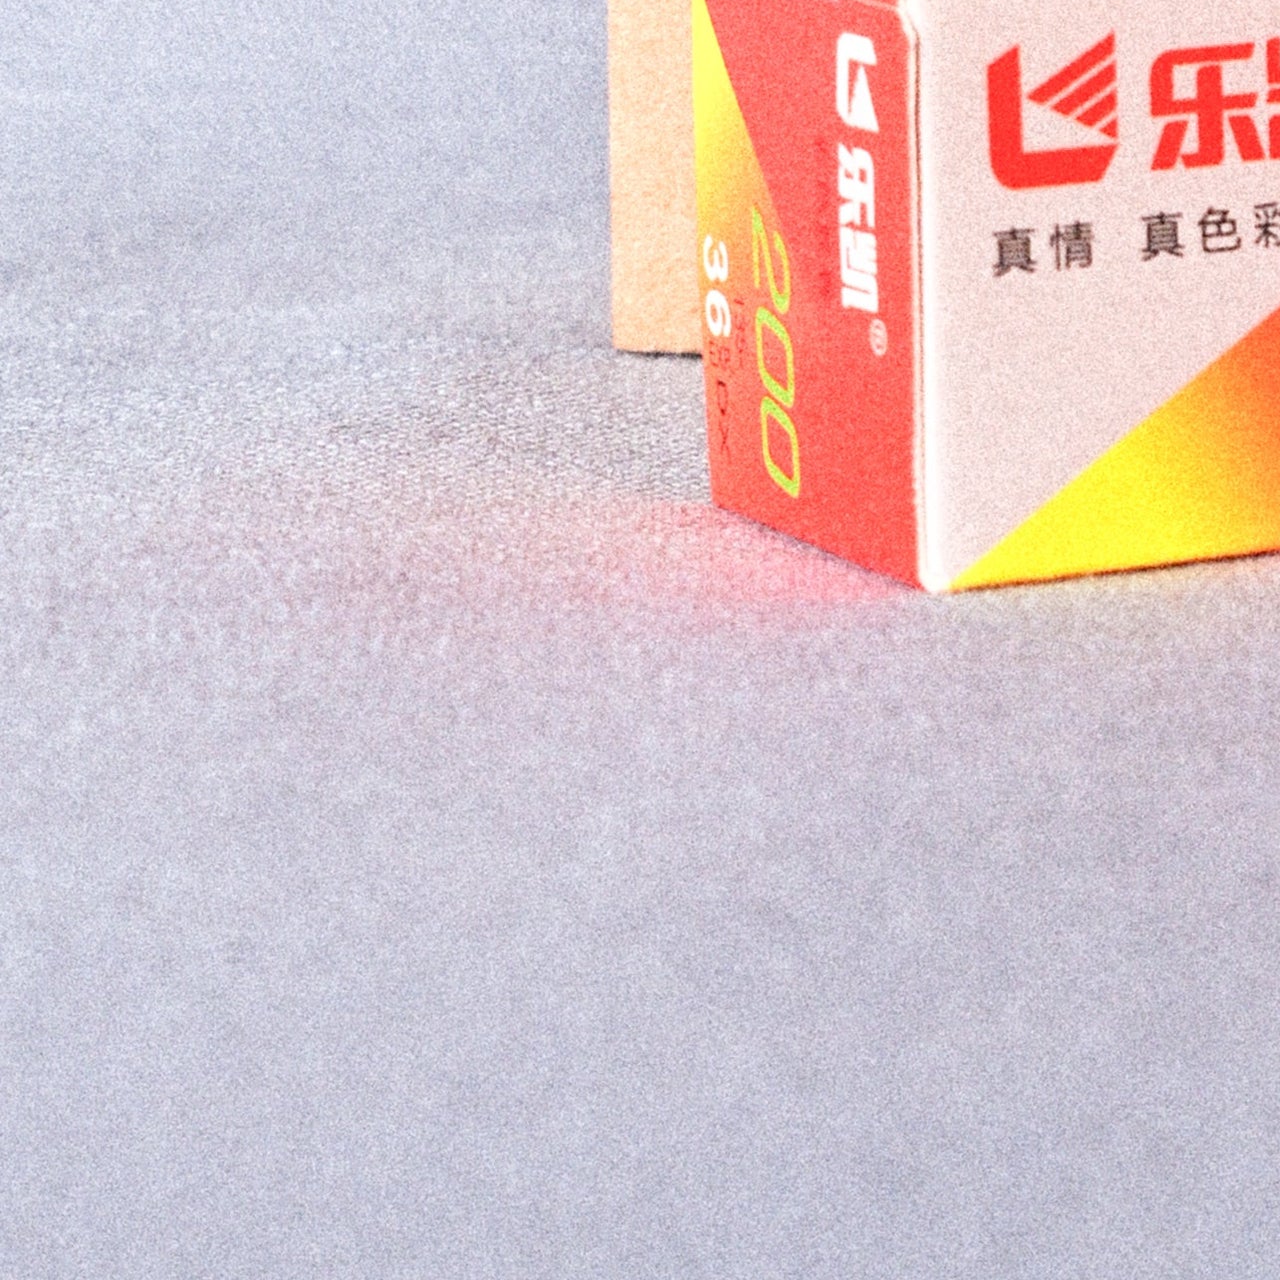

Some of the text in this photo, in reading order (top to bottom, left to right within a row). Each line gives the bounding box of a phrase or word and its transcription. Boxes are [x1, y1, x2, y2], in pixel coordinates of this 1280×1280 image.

[703, 235, 731, 337] 36
[991, 222, 1094, 278] 真情
[752, 206, 800, 498] 200
